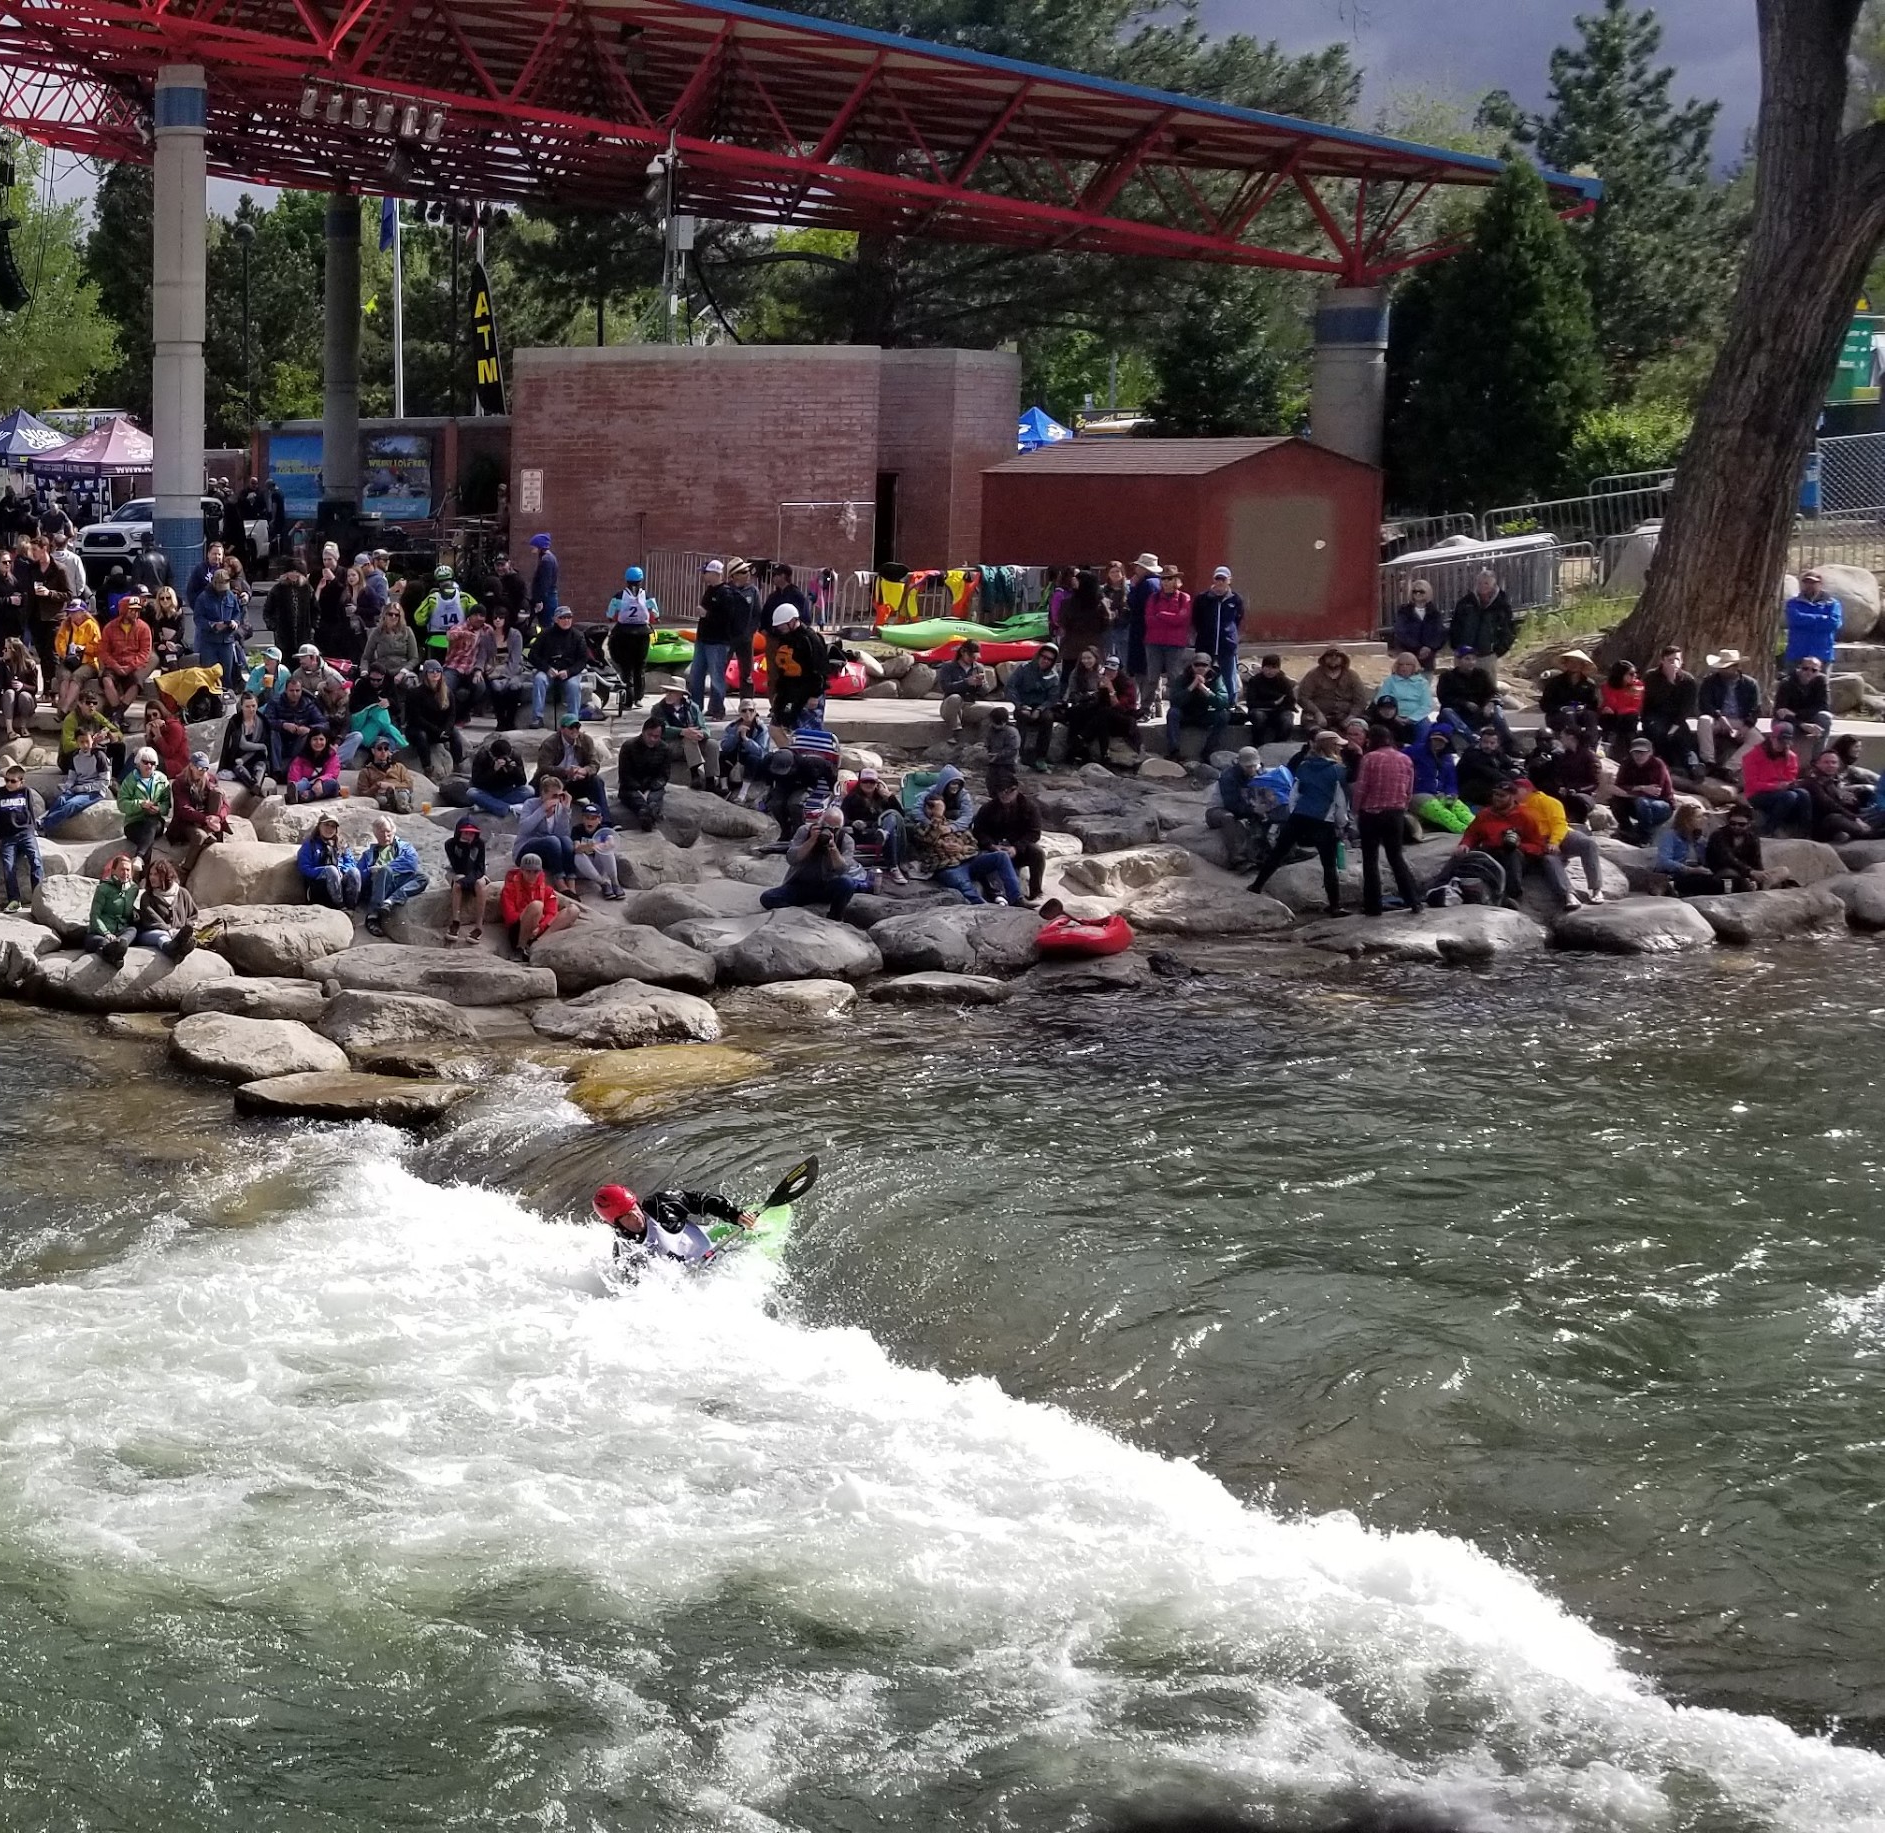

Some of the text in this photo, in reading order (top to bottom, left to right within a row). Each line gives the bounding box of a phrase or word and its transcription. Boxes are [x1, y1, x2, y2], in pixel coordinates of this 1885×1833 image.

[474, 291, 499, 384] ATM
[628, 606, 639, 618] 2
[440, 613, 460, 625] 14
